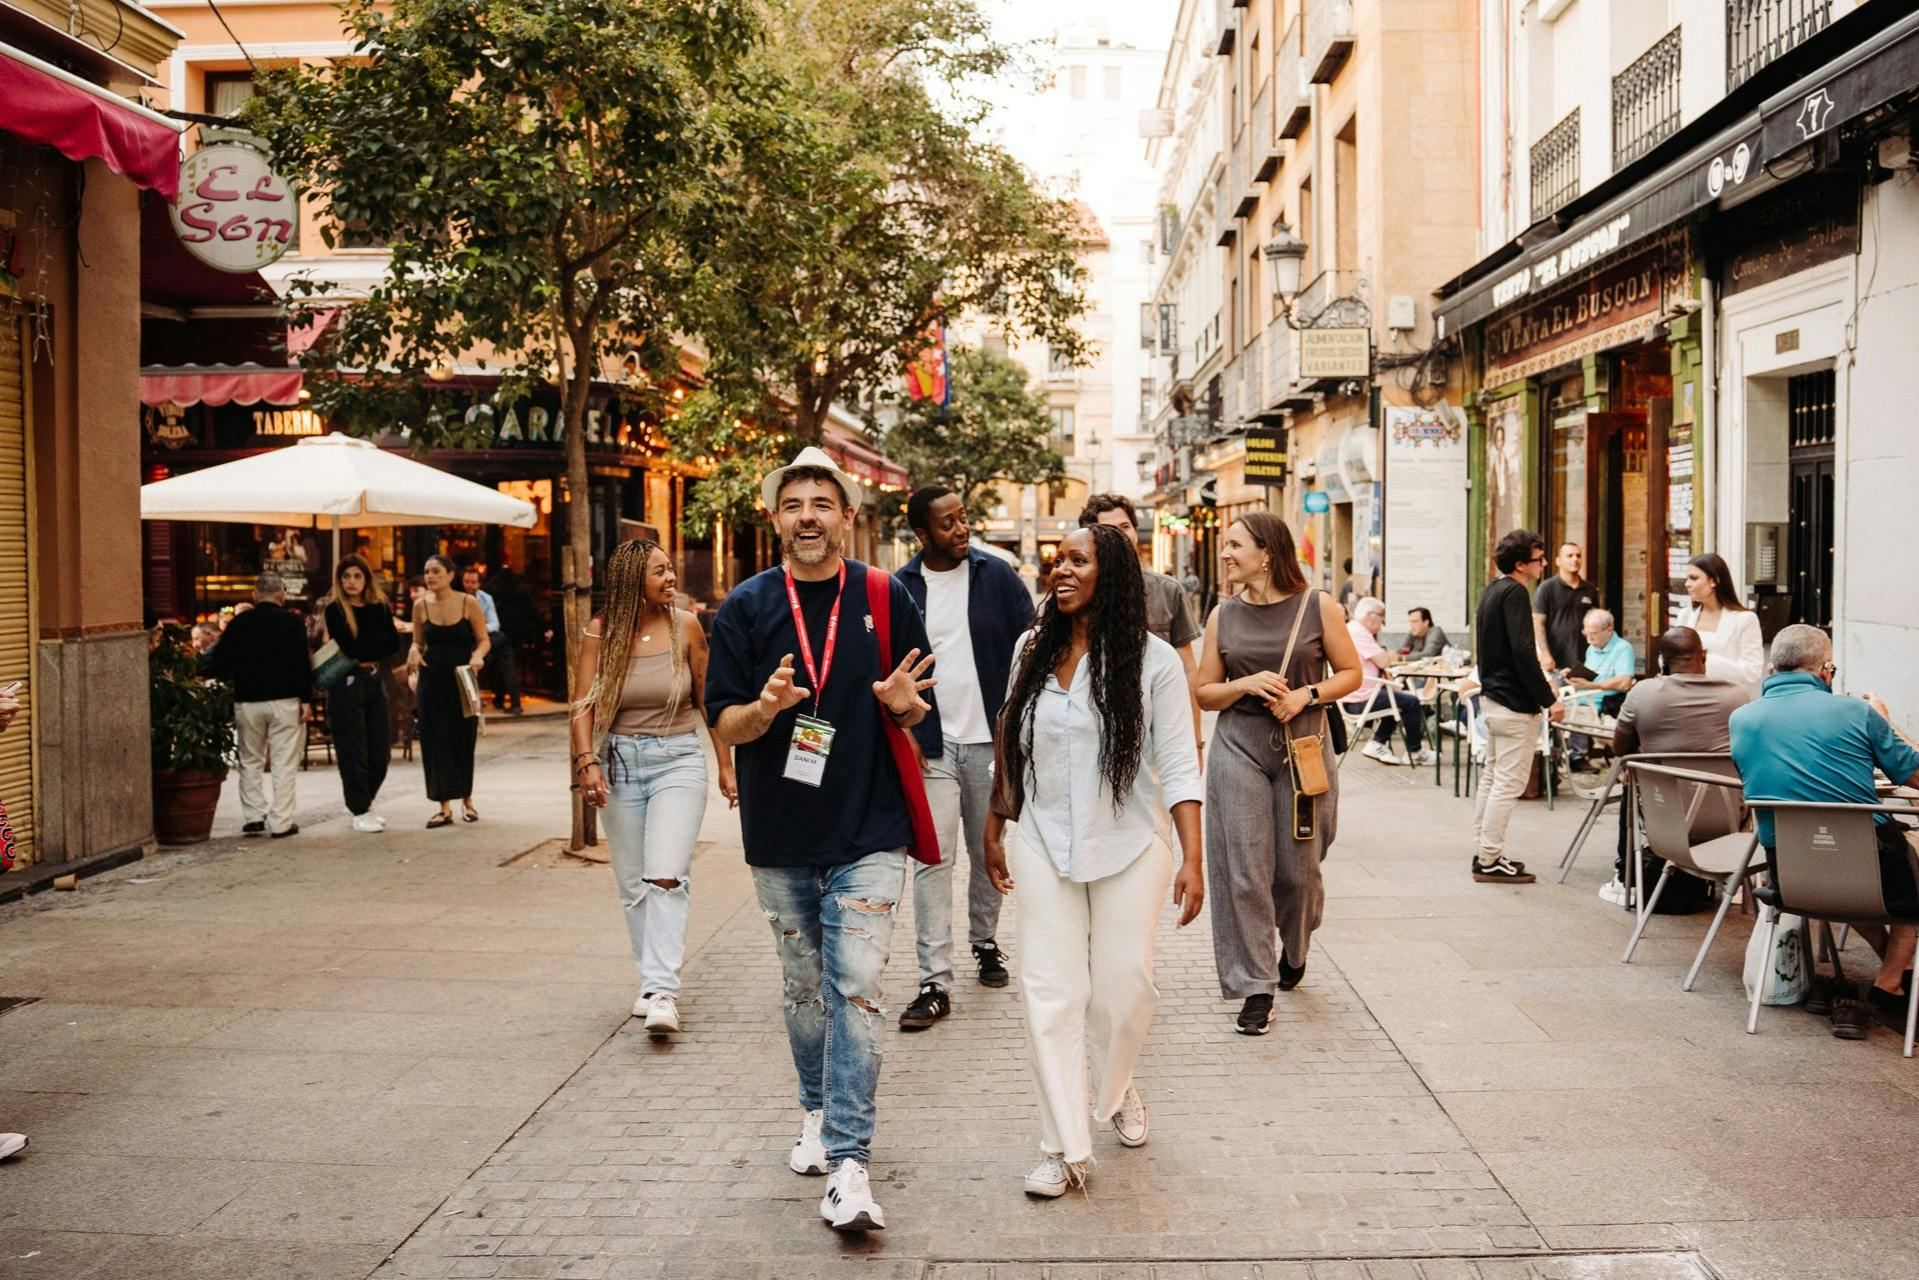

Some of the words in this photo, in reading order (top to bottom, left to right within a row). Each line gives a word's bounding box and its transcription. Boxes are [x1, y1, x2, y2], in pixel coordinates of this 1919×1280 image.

[1807, 95, 1823, 132] 7
[180, 202, 294, 244] Son
[1576, 271, 1651, 323] BUSCON
[1305, 360, 1365, 371] VARIANTES
[253, 409, 323, 436] TABERNA
